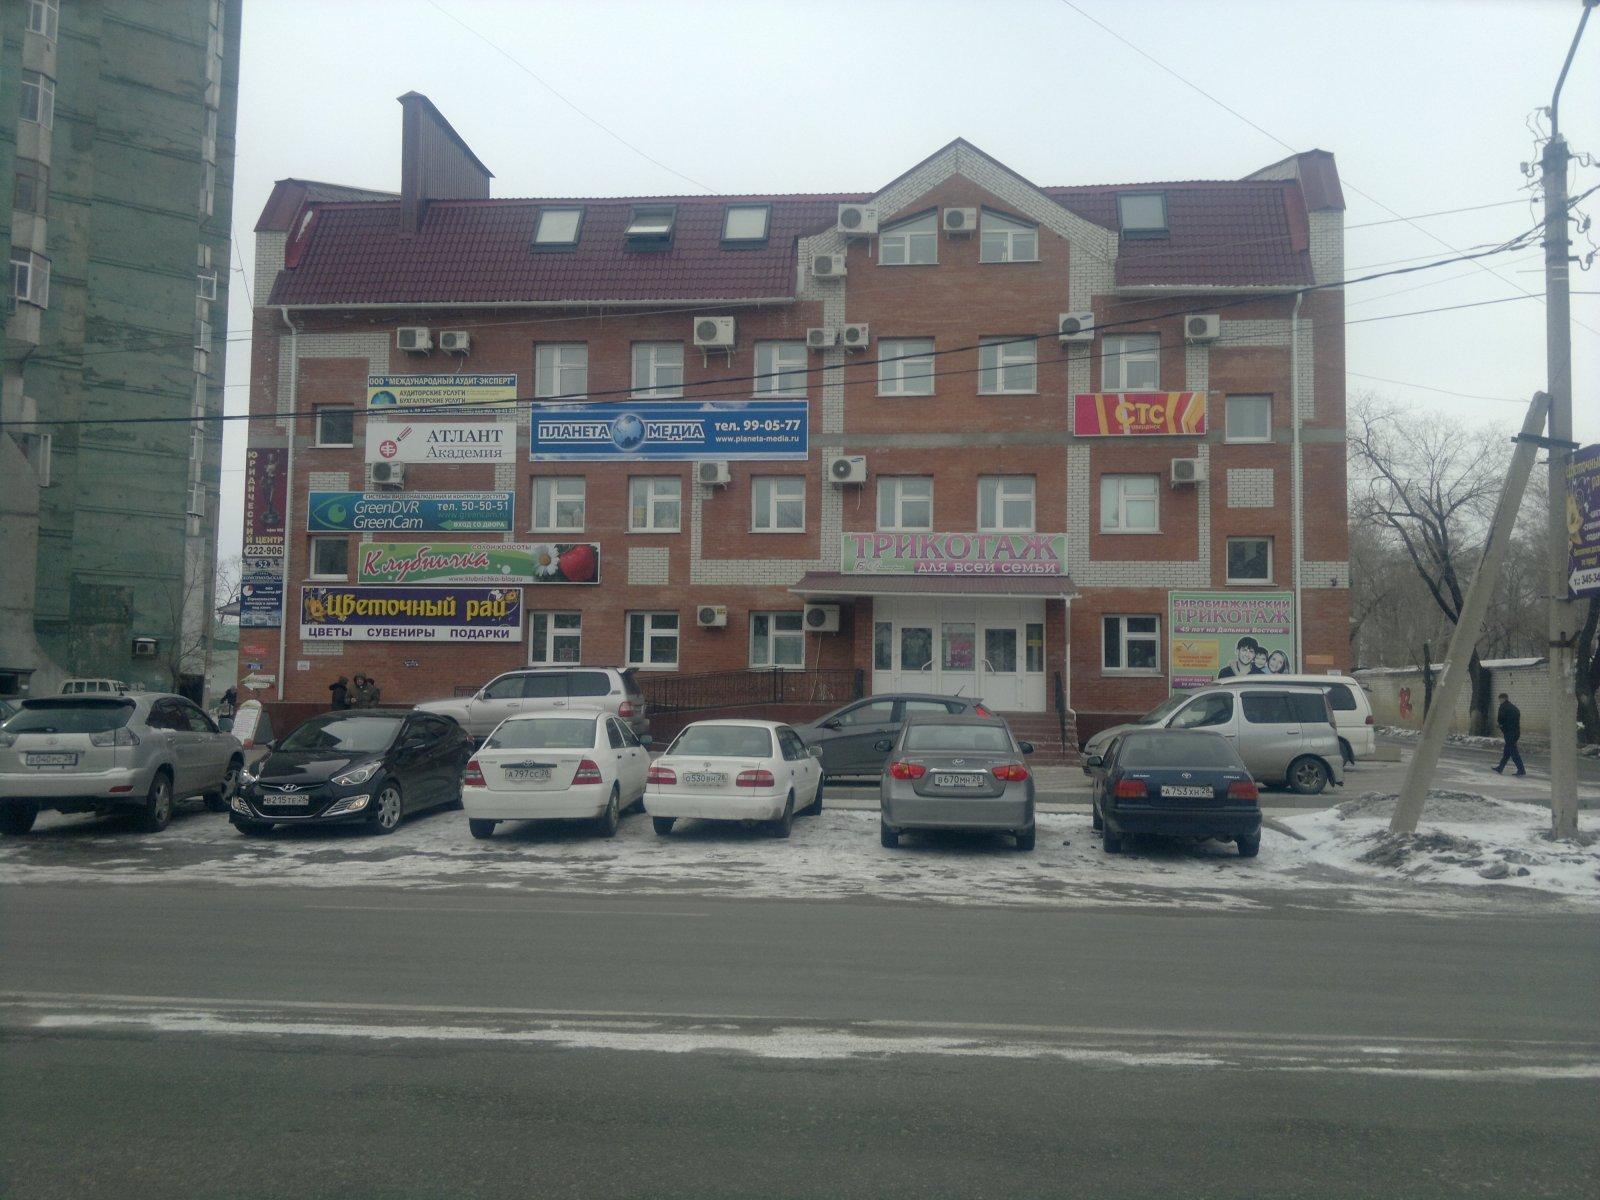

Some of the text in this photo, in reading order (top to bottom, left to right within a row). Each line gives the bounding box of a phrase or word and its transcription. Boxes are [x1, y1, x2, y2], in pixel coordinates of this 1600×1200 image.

[369, 377, 384, 385] ООО
[1115, 401, 1165, 425] СТС
[538, 423, 705, 441] ПЛАНЕТА МЕДИА
[715, 419, 801, 431] тел. 99-05-77
[426, 429, 504, 443] АТЛАНТ
[715, 435, 800, 443] www.planeta-media.ru
[426, 446, 503, 460] Академия
[354, 500, 420, 514] GreenDVR
[437, 501, 508, 511] тел. 50-50-51
[353, 515, 423, 529] GreenCam
[256, 536, 284, 545] ЦЕНТР
[850, 533, 1060, 559] ТРИКОТАЖ
[247, 546, 283, 555] 222-906
[363, 546, 490, 581] Клубничка
[327, 593, 456, 619] Цветочный
[1174, 609, 1292, 624] ТРИКОТАЖ
[308, 627, 510, 640] ЦВЕТЫ СУВЕНИРЫ ПОДАРКИ
